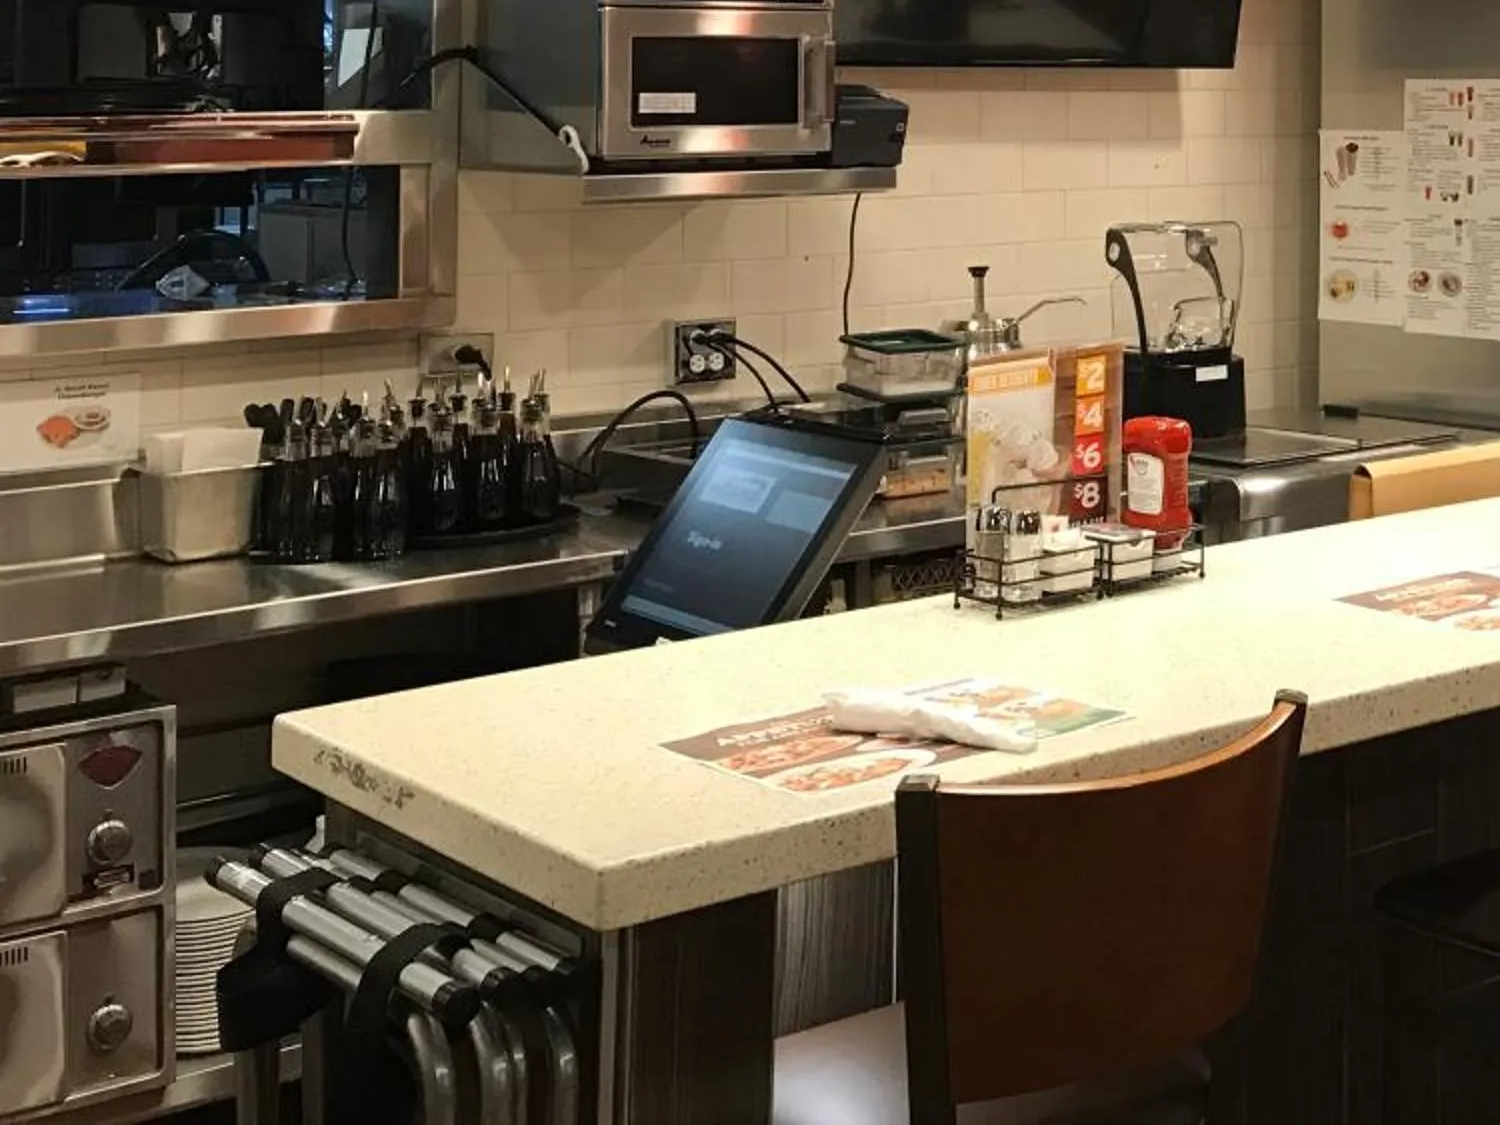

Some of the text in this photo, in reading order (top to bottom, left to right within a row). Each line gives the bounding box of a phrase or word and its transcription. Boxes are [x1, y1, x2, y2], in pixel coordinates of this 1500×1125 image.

[1078, 401, 1103, 428] $4
[1075, 442, 1102, 469] $6
[1073, 481, 1101, 509] $8
